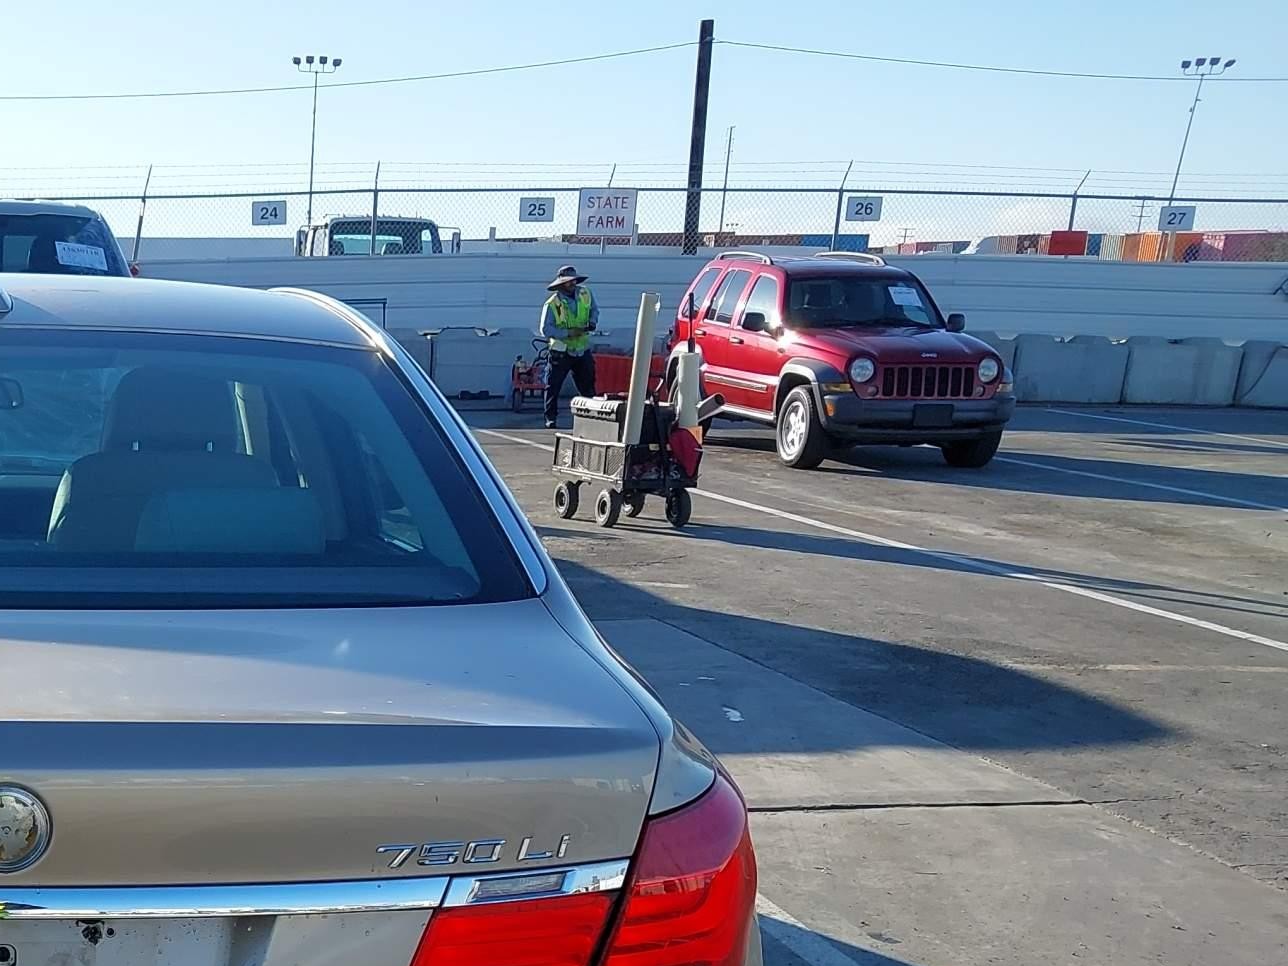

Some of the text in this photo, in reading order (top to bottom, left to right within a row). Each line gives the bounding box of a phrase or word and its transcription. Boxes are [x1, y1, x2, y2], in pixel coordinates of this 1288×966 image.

[586, 196, 630, 209] STATE
[855, 202, 874, 216] 26
[260, 206, 279, 220] 24
[527, 203, 546, 217] 25
[586, 215, 626, 229] FARM
[1166, 212, 1187, 226] 27
[376, 839, 507, 868] 750
